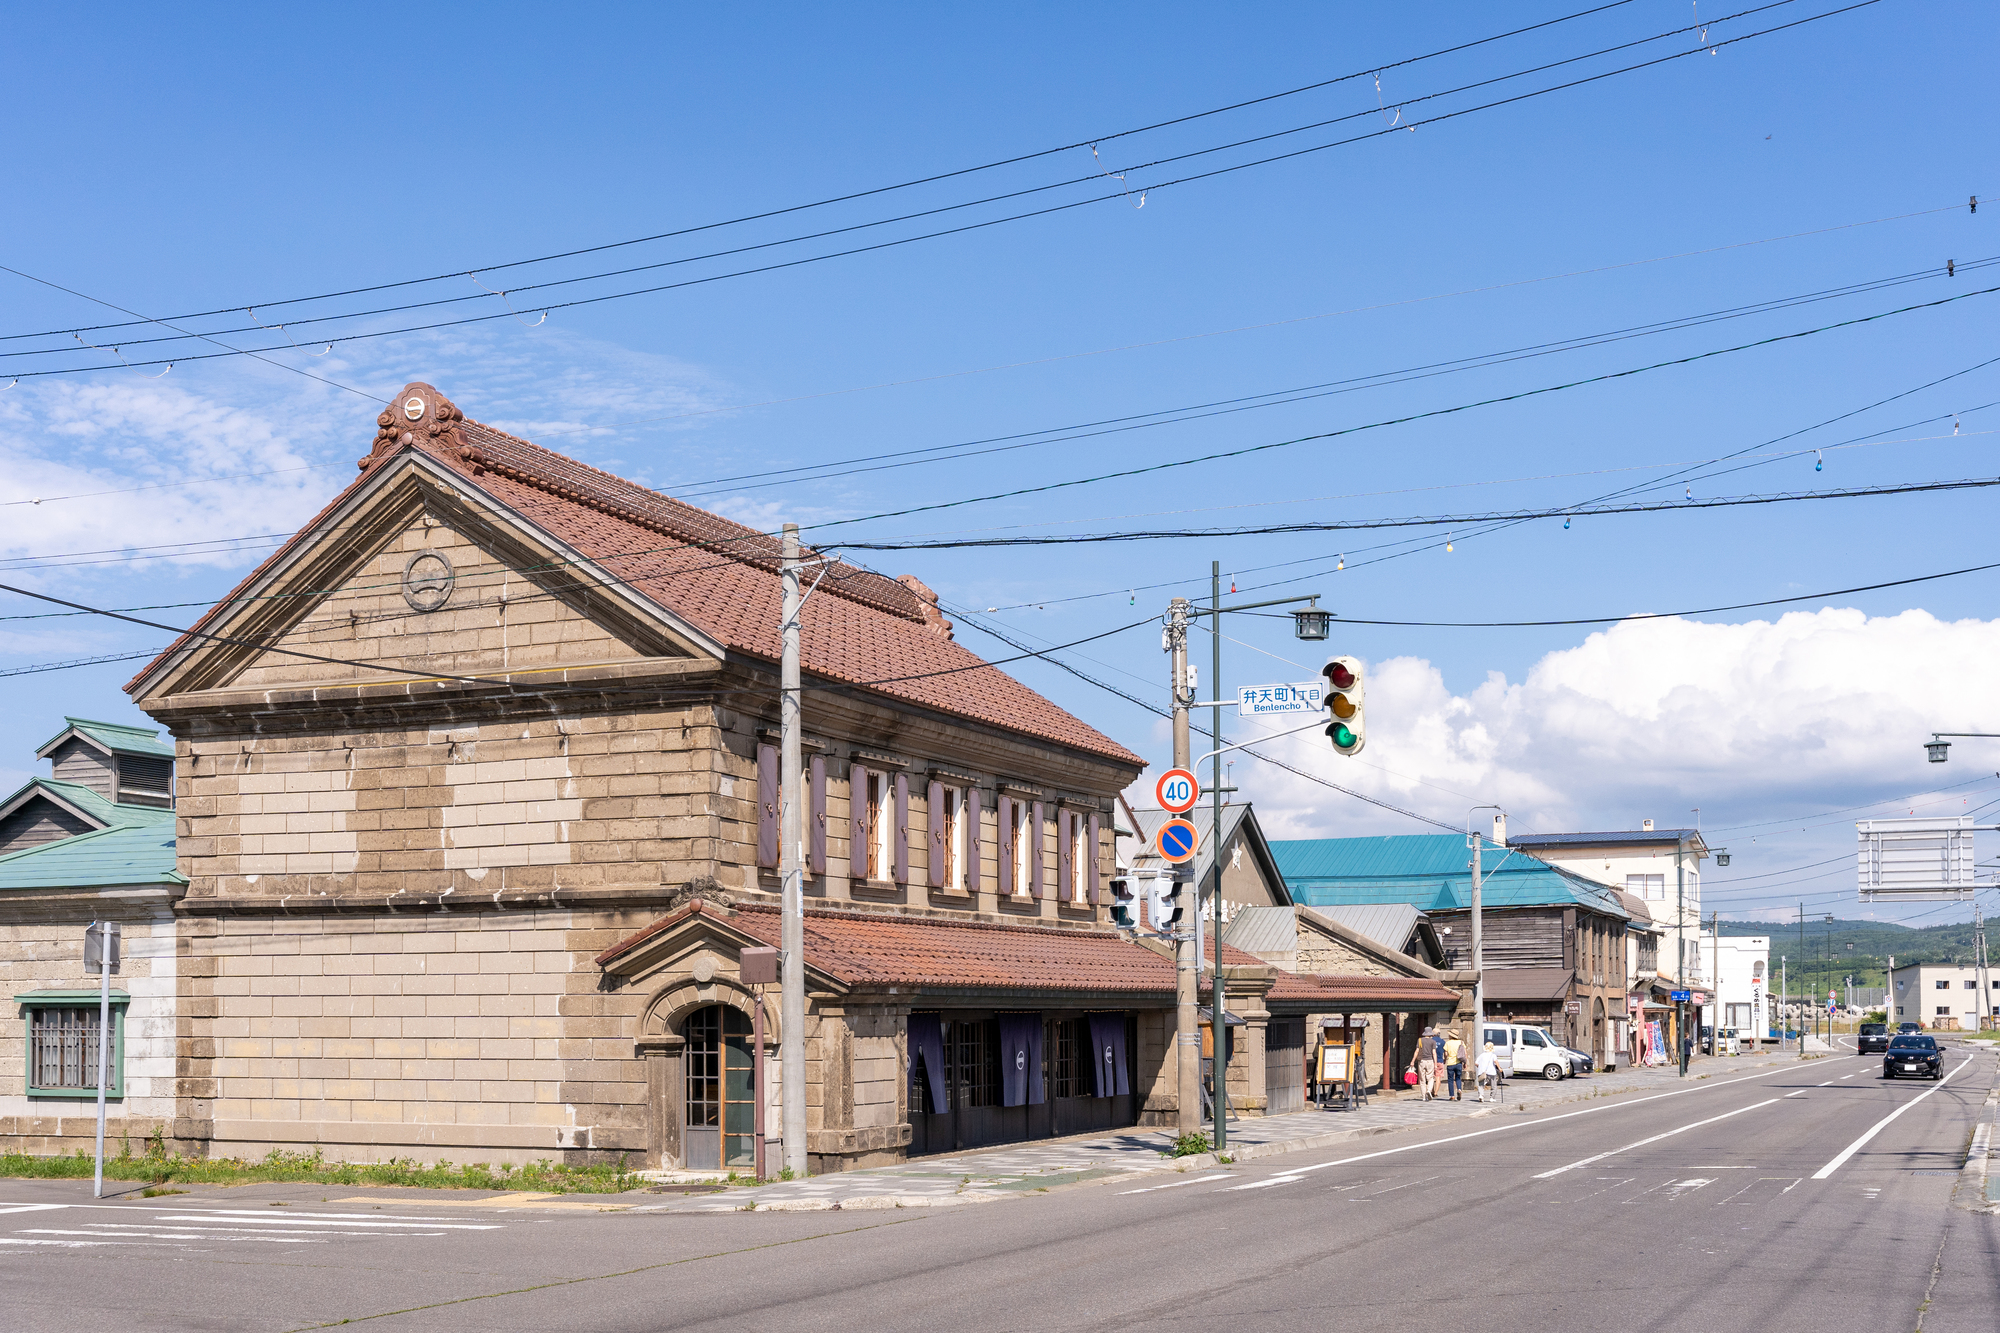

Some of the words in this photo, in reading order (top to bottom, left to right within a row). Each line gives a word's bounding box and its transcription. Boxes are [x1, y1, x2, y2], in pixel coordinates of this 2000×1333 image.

[1243, 687, 1320, 704] 弁天町1丁目
[1254, 702, 1301, 712] Bentencho
[1305, 701, 1309, 709] 1
[1166, 781, 1189, 801] 40
